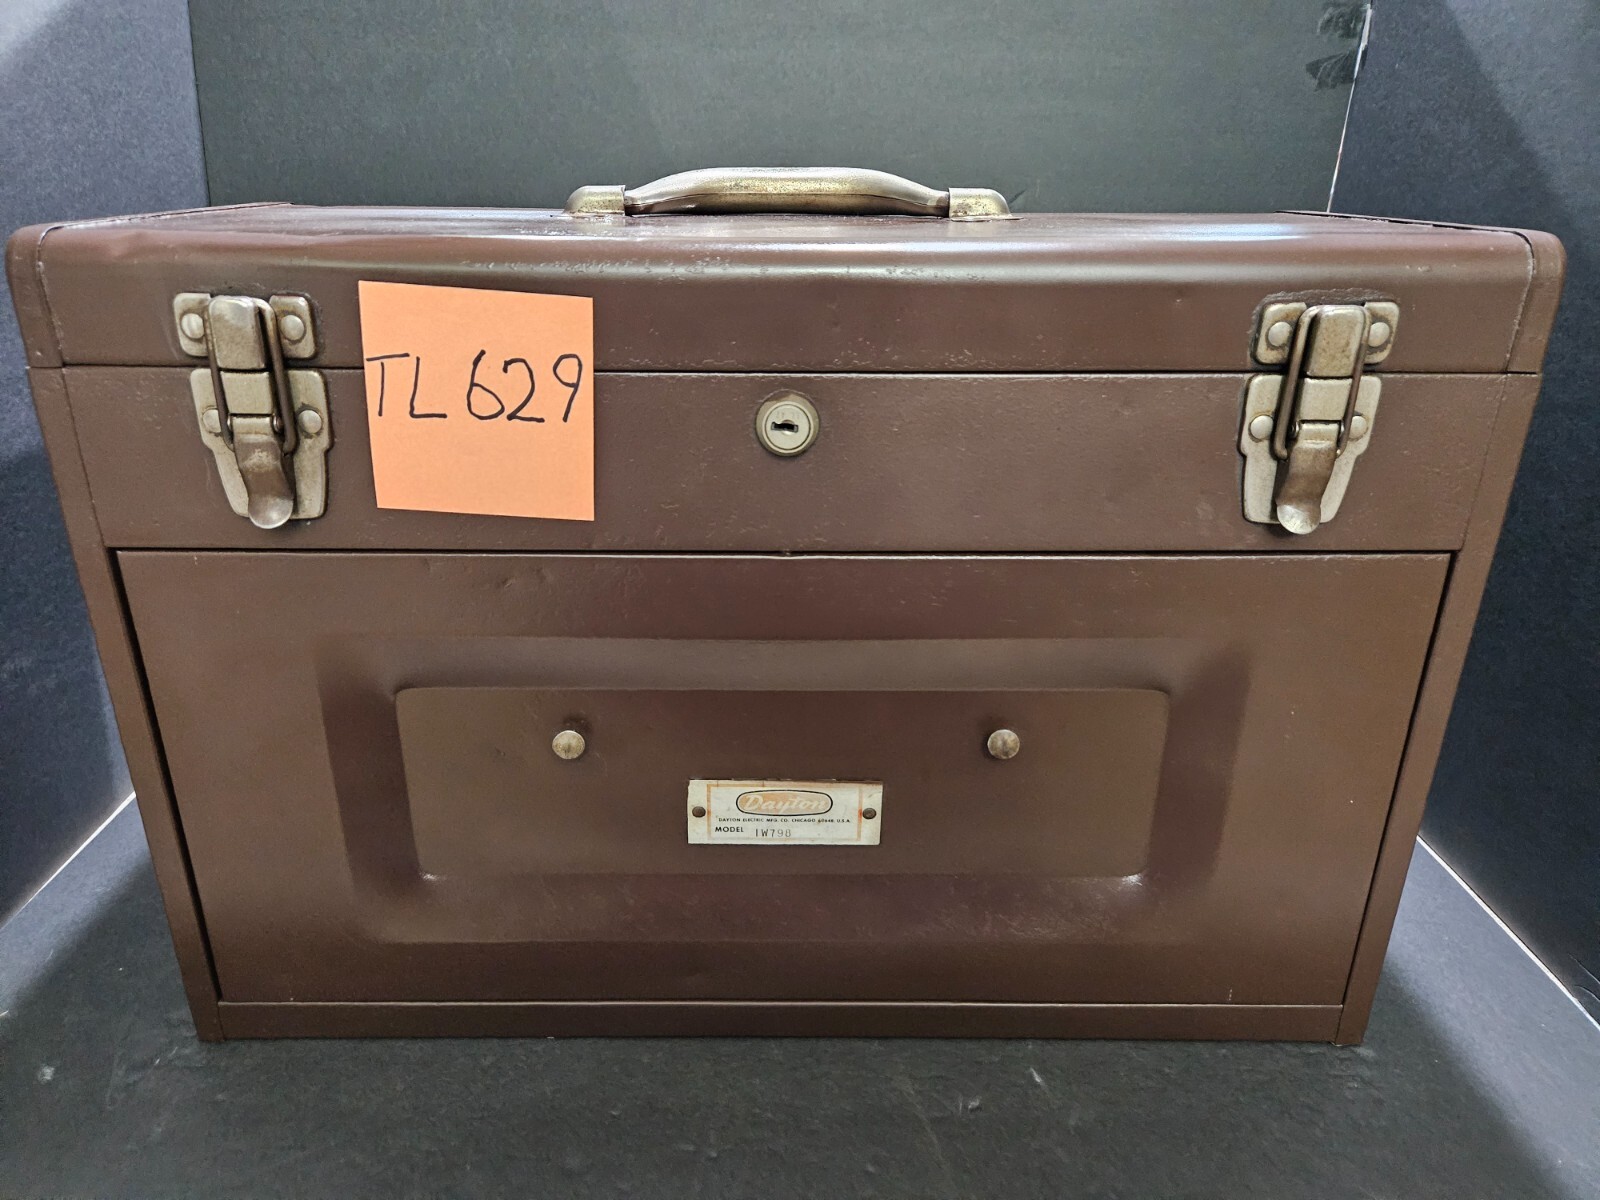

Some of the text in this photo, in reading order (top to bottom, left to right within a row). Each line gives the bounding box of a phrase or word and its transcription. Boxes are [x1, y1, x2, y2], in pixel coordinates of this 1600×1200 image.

[366, 349, 583, 423] TL 629
[744, 794, 826, 814] Dayton
